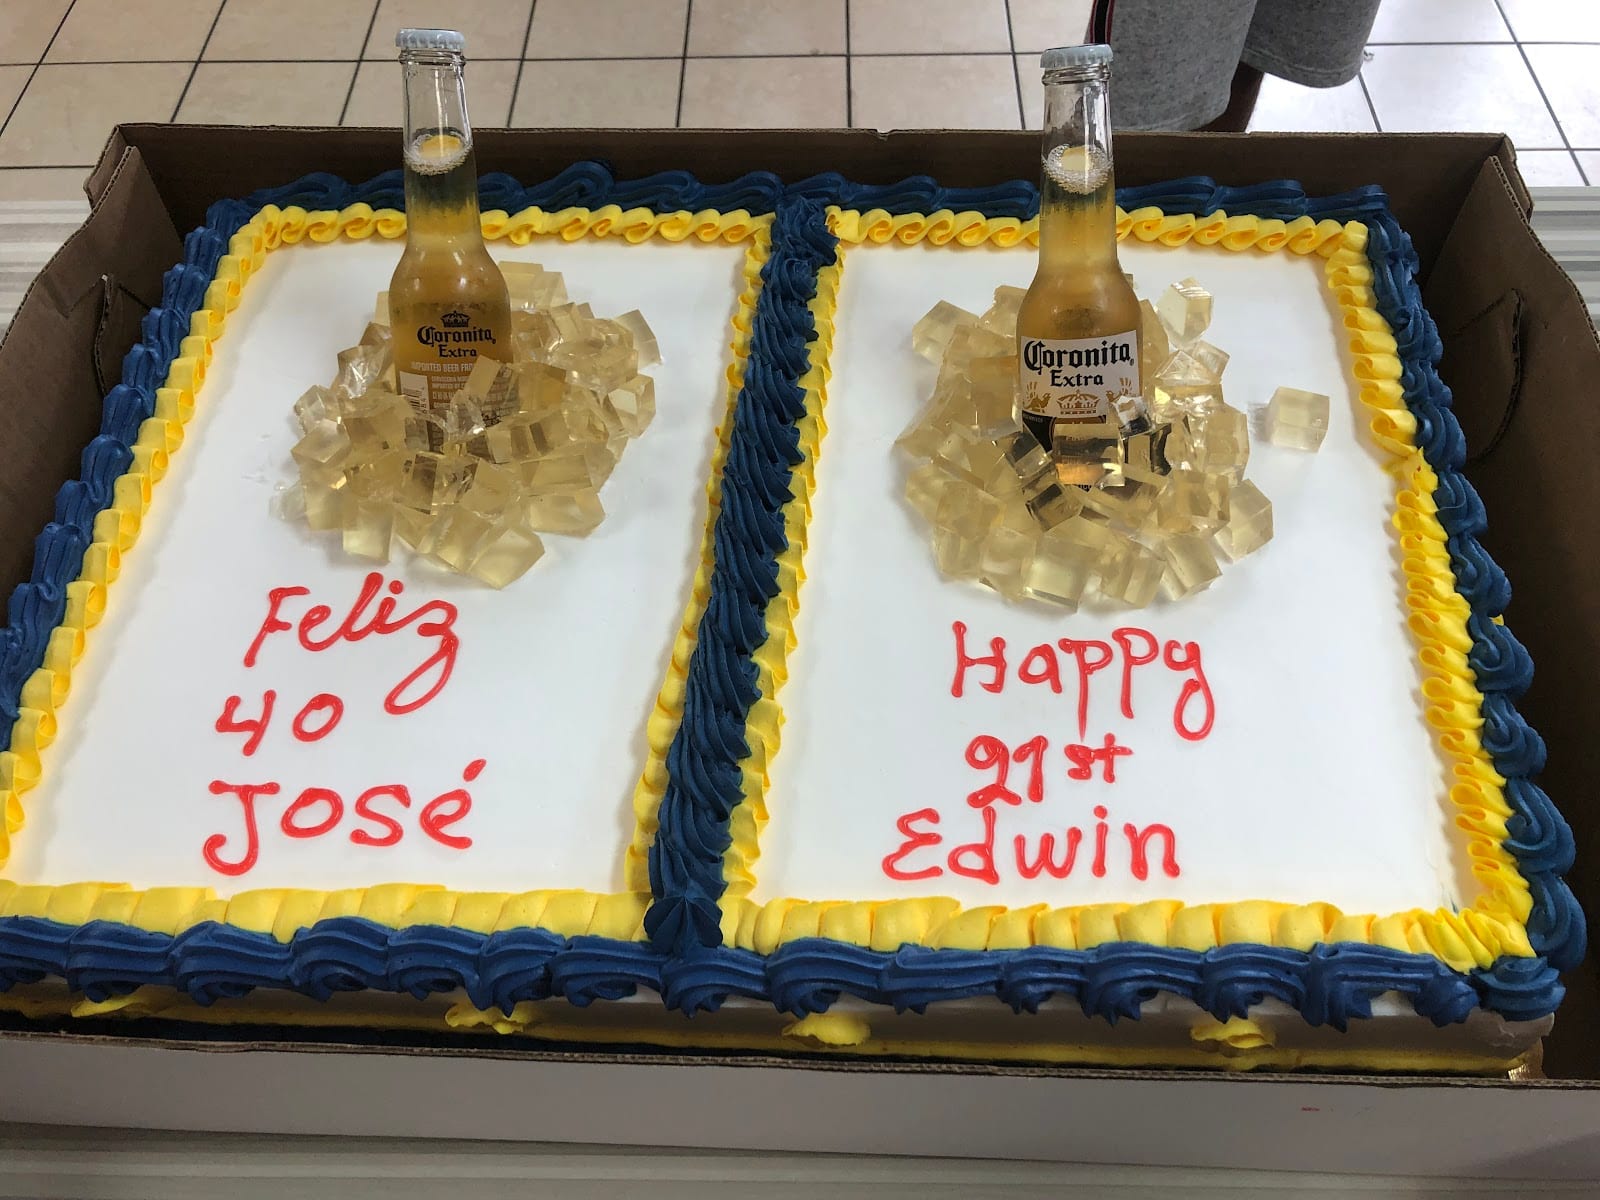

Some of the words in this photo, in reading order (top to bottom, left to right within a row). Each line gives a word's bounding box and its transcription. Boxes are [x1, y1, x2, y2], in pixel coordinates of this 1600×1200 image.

[417, 326, 496, 347] Coronita
[439, 344, 478, 357] Extra
[1024, 340, 1133, 375] Coronita
[461, 364, 475, 373] FRO
[1050, 370, 1104, 387] Extra
[244, 572, 459, 716] Feliz
[951, 621, 1215, 742] Happy
[215, 690, 344, 757] 40
[202, 759, 487, 877] José
[882, 805, 1181, 886] Edwin
